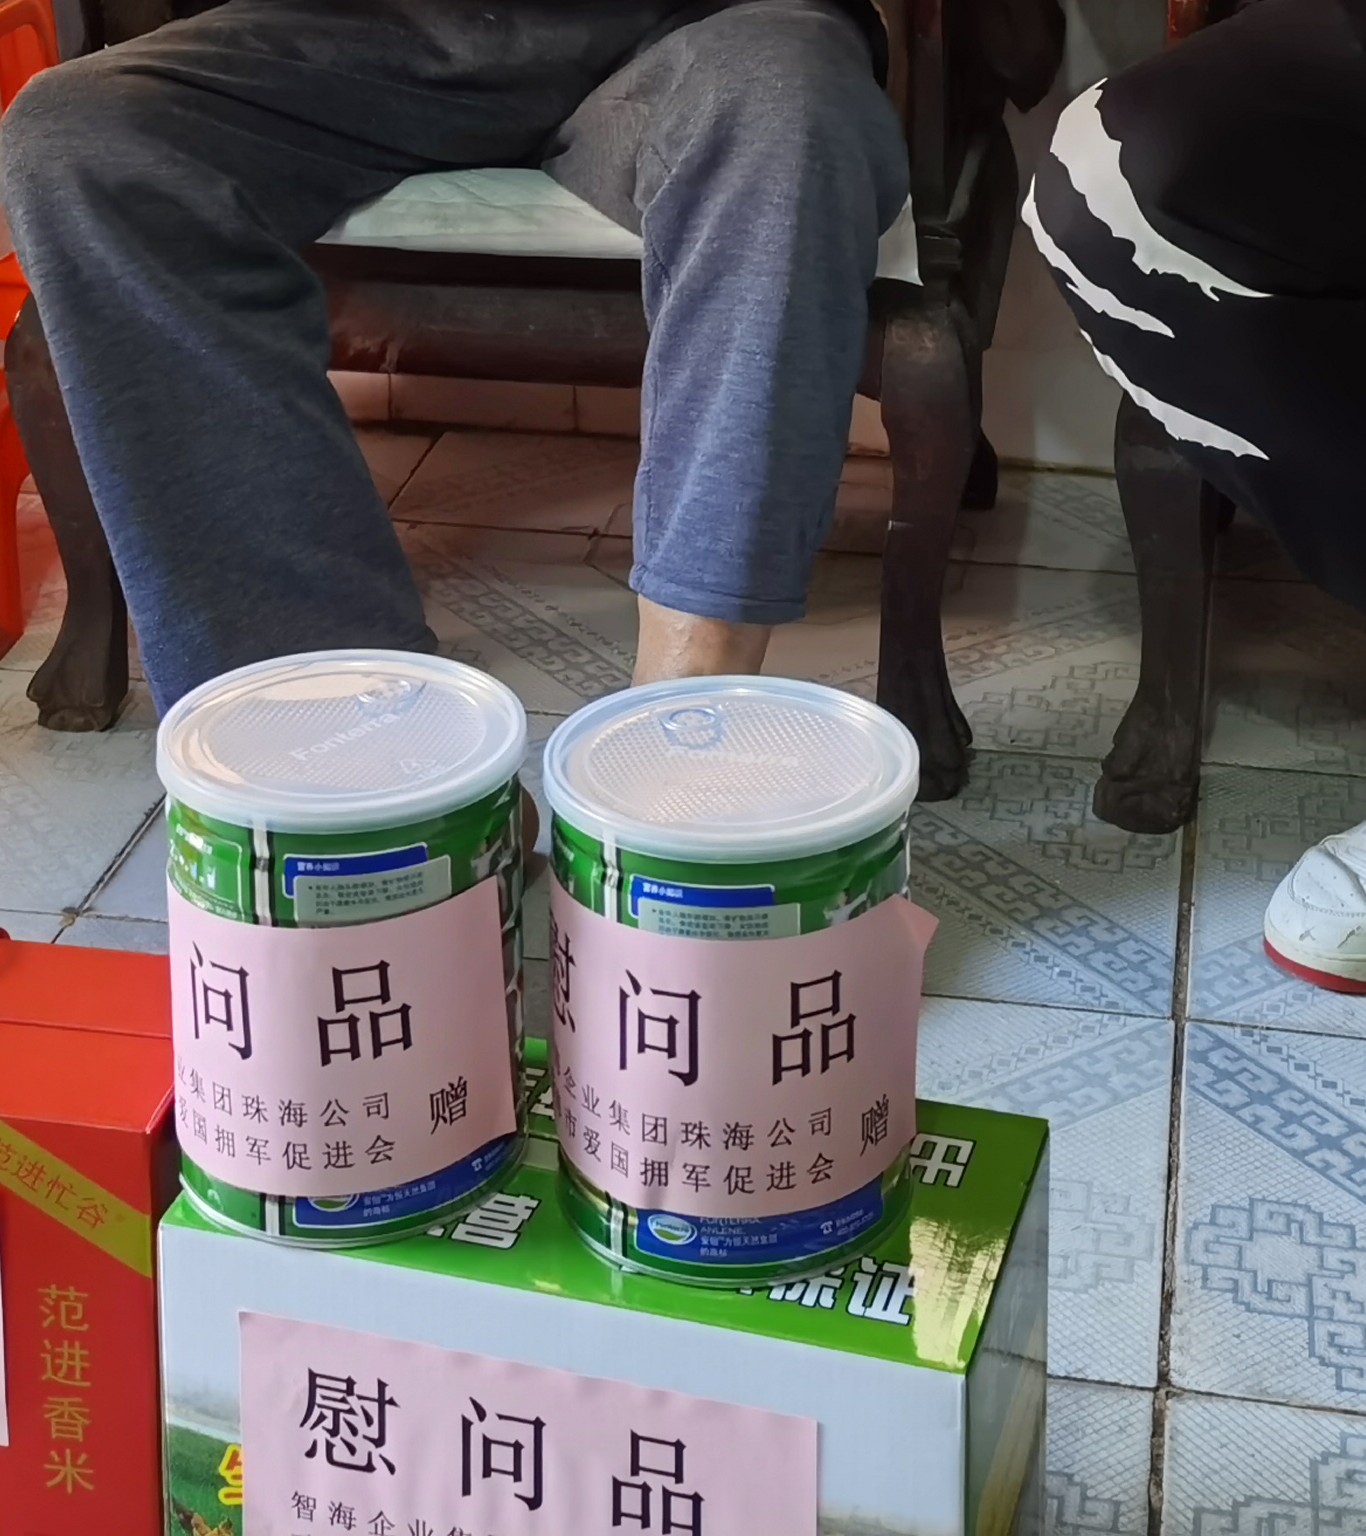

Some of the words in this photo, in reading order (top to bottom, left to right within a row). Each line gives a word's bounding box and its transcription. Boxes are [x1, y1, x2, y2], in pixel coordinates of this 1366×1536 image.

[290, 711, 401, 762] Fonterra
[428, 1075, 469, 1135] 赠
[859, 1093, 890, 1158] 赠
[37, 1284, 95, 1495] 范进香米
[299, 1367, 705, 1536] 慰问品
